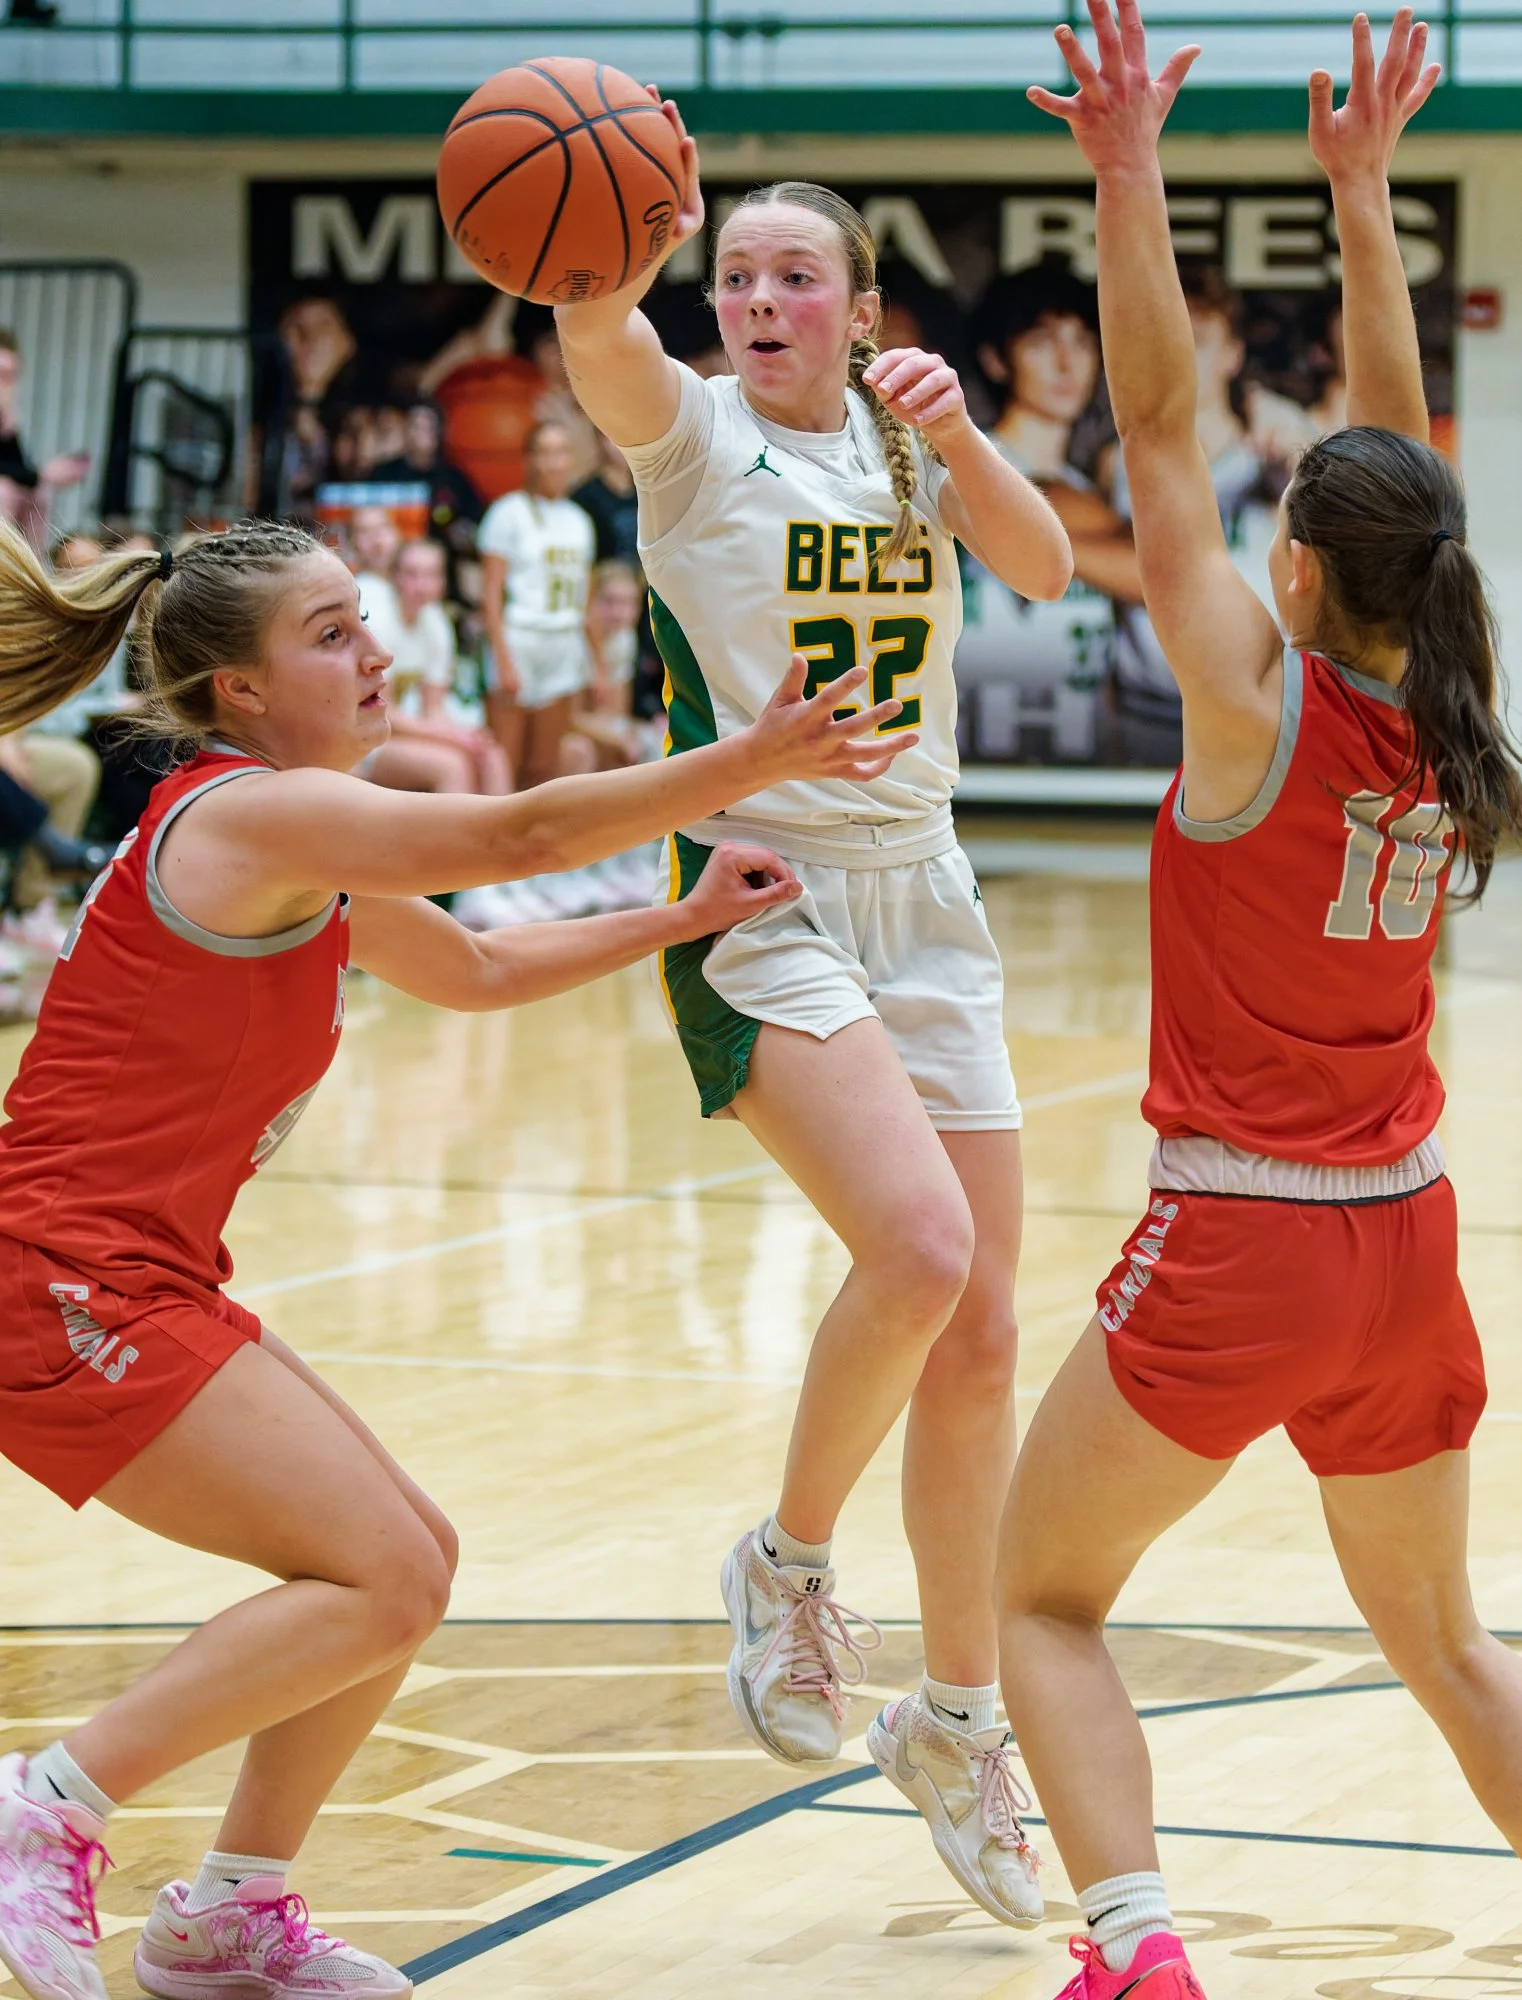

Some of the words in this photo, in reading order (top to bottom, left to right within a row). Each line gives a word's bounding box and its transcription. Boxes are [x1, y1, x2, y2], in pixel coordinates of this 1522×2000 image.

[784, 520, 936, 596] BEES
[788, 613, 935, 737] 22
[1323, 789, 1456, 941] 10
